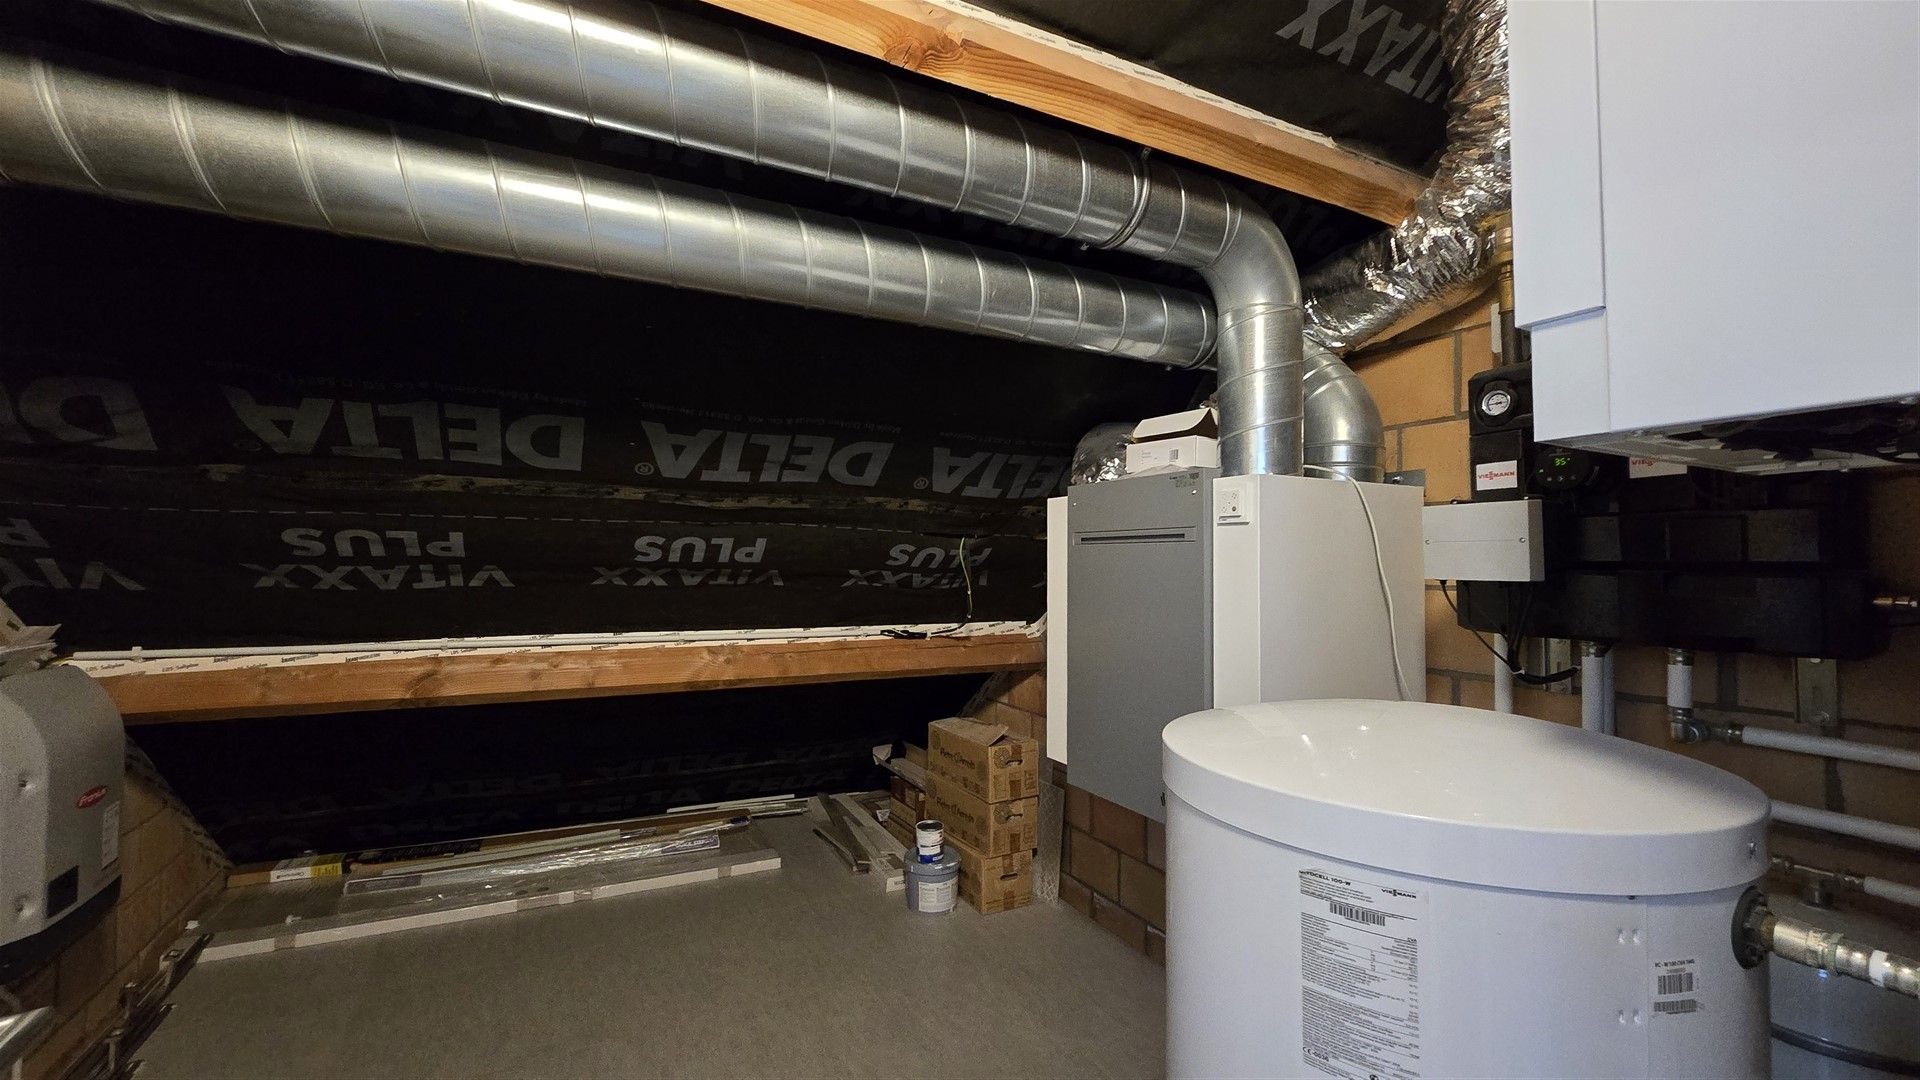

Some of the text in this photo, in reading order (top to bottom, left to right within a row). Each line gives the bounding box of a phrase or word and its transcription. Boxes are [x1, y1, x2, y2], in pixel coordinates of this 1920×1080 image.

[281, 527, 465, 558] PLUS
[633, 535, 768, 564] PLUS
[885, 543, 992, 570] PLUS
[241, 562, 515, 591] VITAXX
[591, 566, 785, 588] VITAXX
